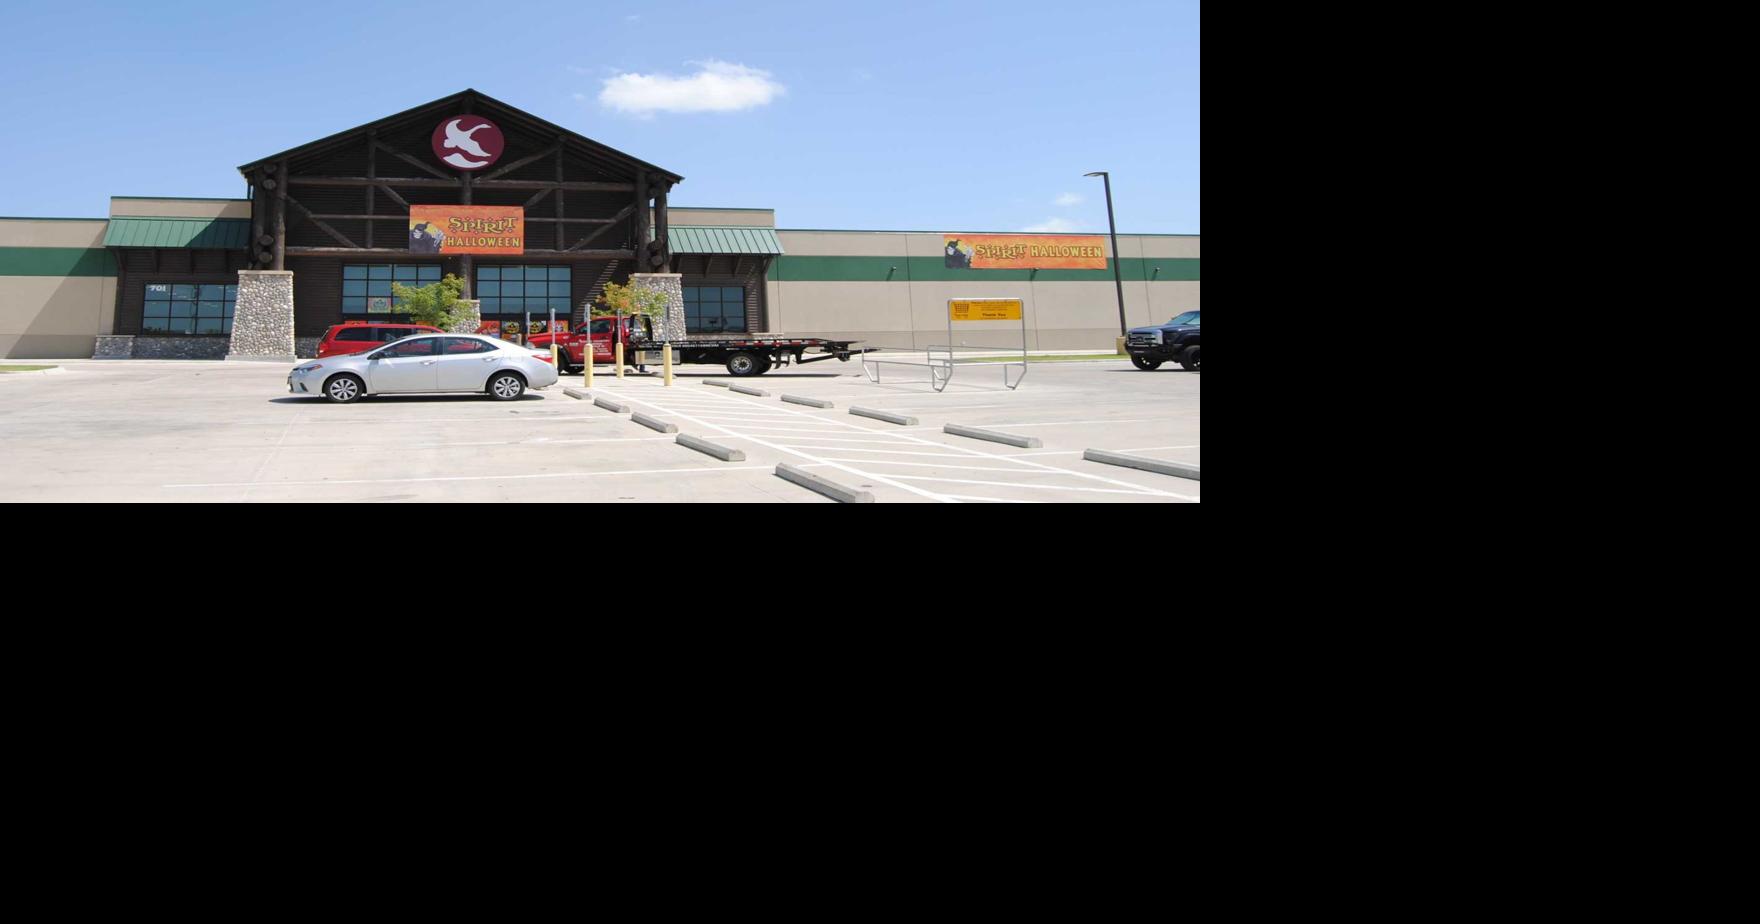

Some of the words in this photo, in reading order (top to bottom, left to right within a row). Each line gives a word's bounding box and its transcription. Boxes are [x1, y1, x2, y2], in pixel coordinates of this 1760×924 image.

[448, 216, 517, 234] SPIRIT
[447, 237, 520, 247] HALLOWEEN
[975, 243, 1028, 260] SPIRIT
[1030, 245, 1103, 258] HALLOWEEN
